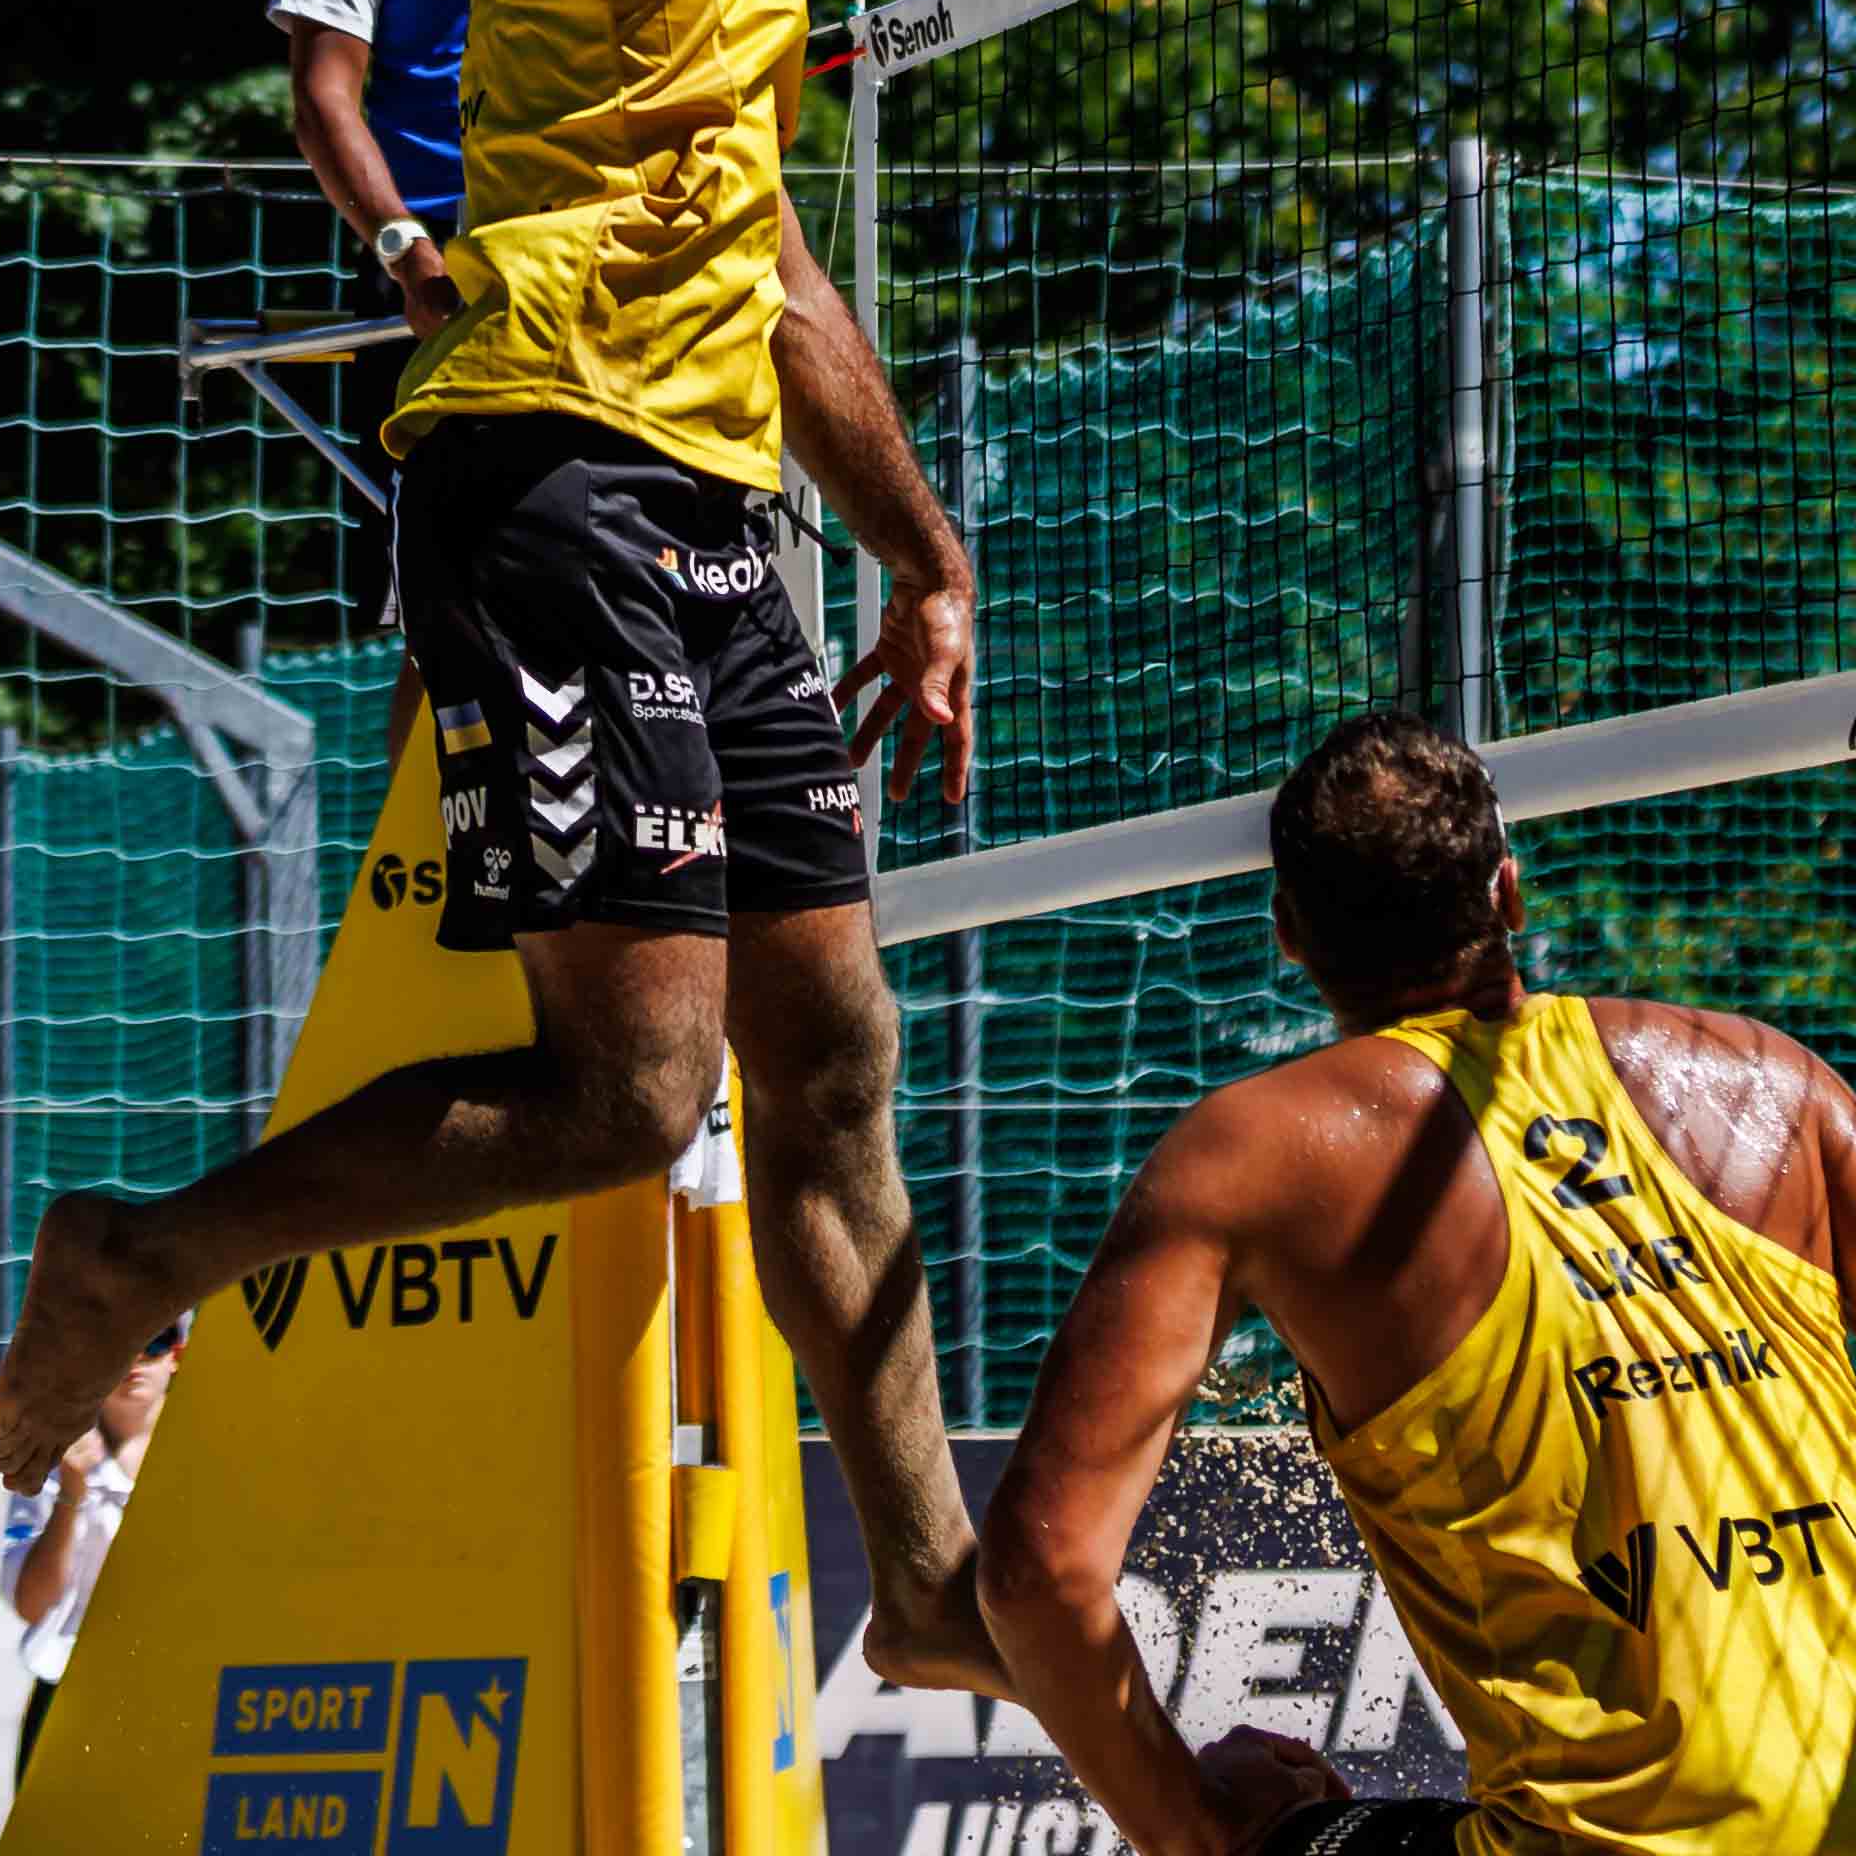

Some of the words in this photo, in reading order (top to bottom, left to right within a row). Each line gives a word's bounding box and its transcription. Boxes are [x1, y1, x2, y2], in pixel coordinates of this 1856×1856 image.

[888, 0, 956, 61] Senoh
[1523, 1112, 1635, 1211] 2
[329, 1235, 559, 1330] VBTV
[1573, 1328, 1782, 1420] Reznik
[234, 1685, 373, 1734] SPORT
[234, 1796, 349, 1841] LAND
